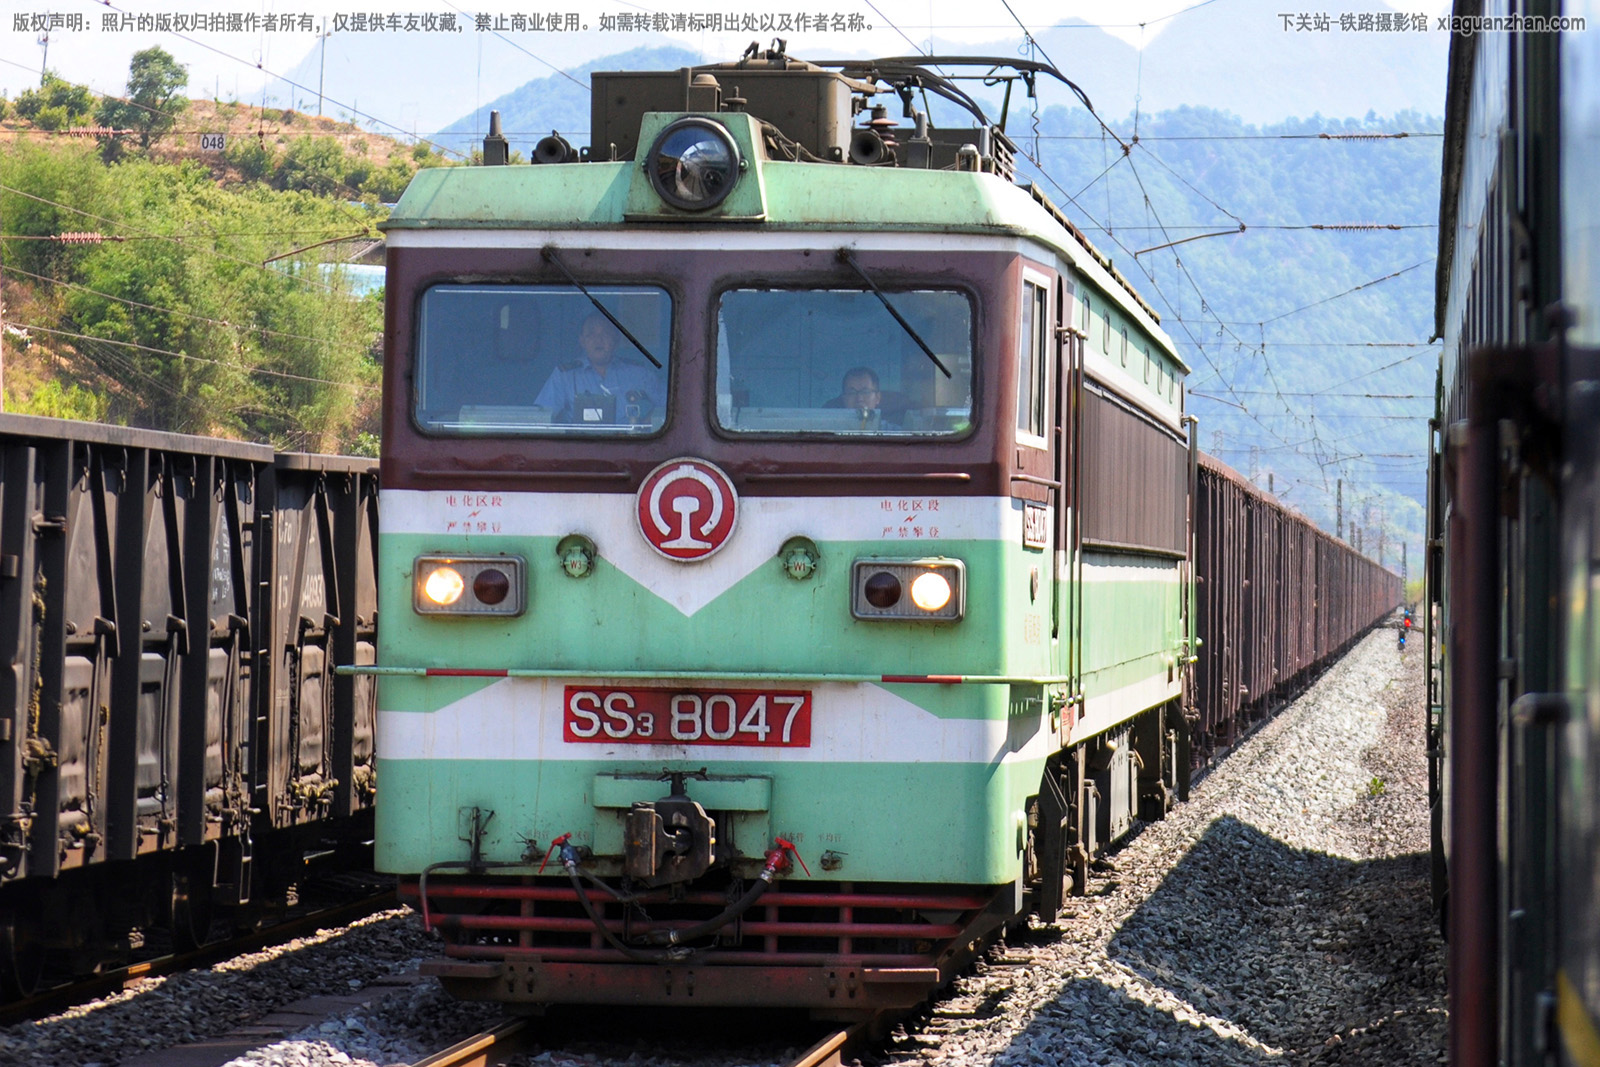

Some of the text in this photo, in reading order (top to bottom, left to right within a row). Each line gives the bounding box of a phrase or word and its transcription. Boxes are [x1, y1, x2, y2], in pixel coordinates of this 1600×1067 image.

[201, 136, 225, 150] 048
[445, 494, 503, 507] 电化区段
[880, 499, 940, 512] 电化区段
[569, 690, 805, 744] SS3 8047
